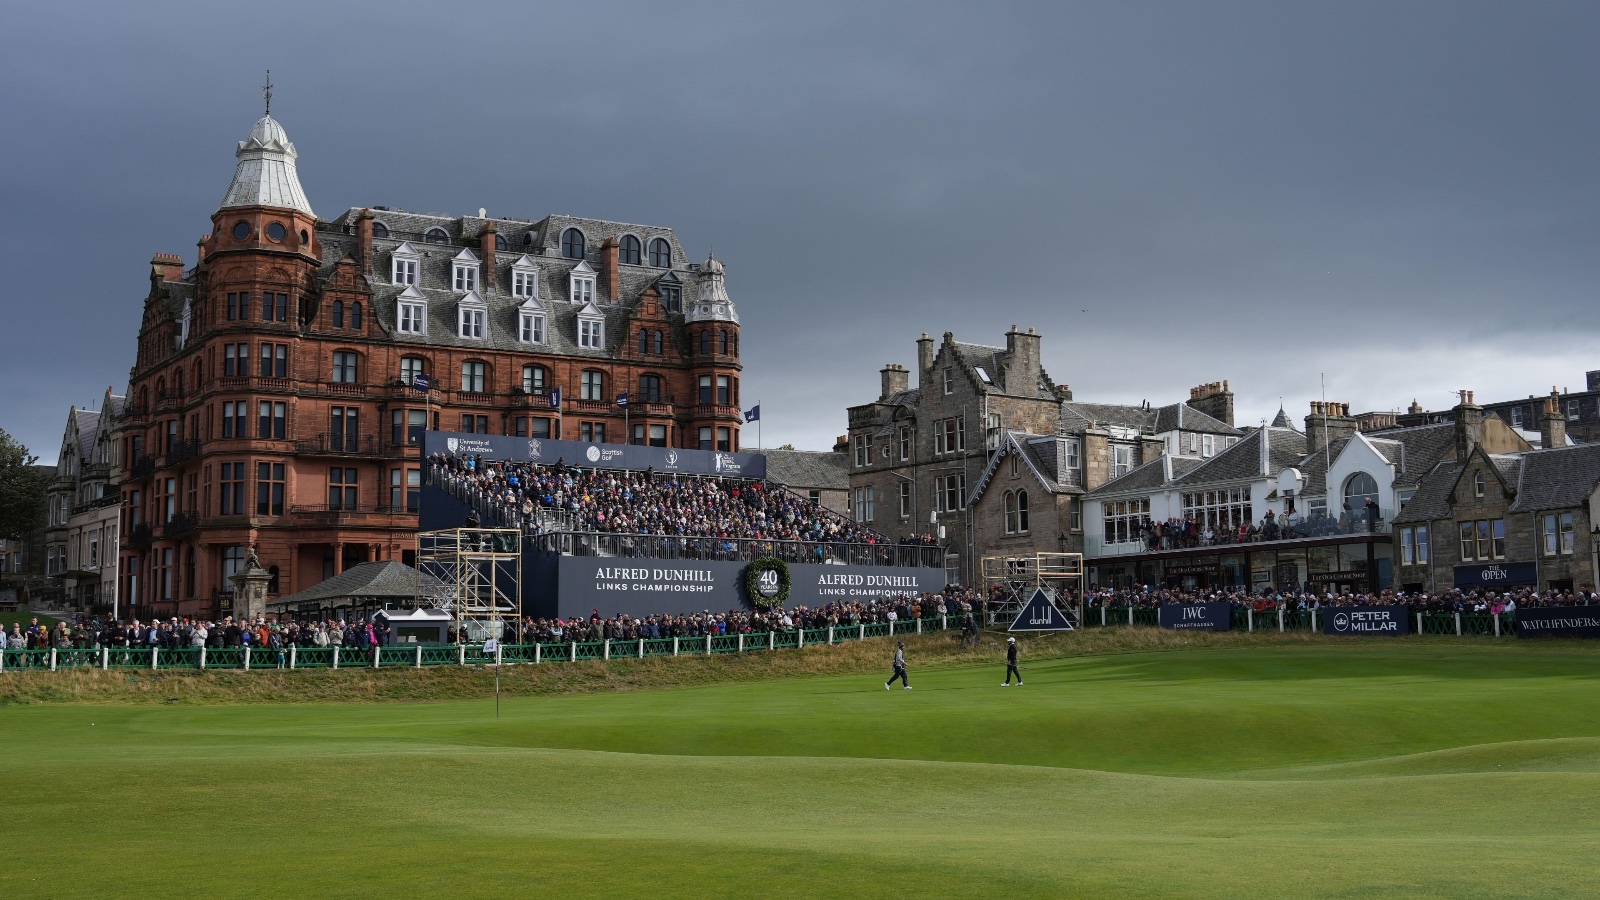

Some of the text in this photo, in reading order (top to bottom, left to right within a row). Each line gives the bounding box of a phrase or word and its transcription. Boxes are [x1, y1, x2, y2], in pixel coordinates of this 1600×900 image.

[459, 438, 483, 447] University
[601, 448, 624, 457] Scottish
[595, 567, 715, 582] ALFRED DUNHILL
[759, 569, 778, 585] 40
[817, 573, 919, 587] ALFRED DUNHILL
[1481, 569, 1507, 581] OPEN
[596, 582, 714, 593] LINKS CHAMPIONSHIP
[819, 588, 918, 597] LINKS CHAMPIONSHIP
[1029, 605, 1052, 625] dunhill
[1182, 606, 1206, 620] IWC
[1351, 611, 1390, 621] PETER
[1351, 621, 1397, 631] MILLAR
